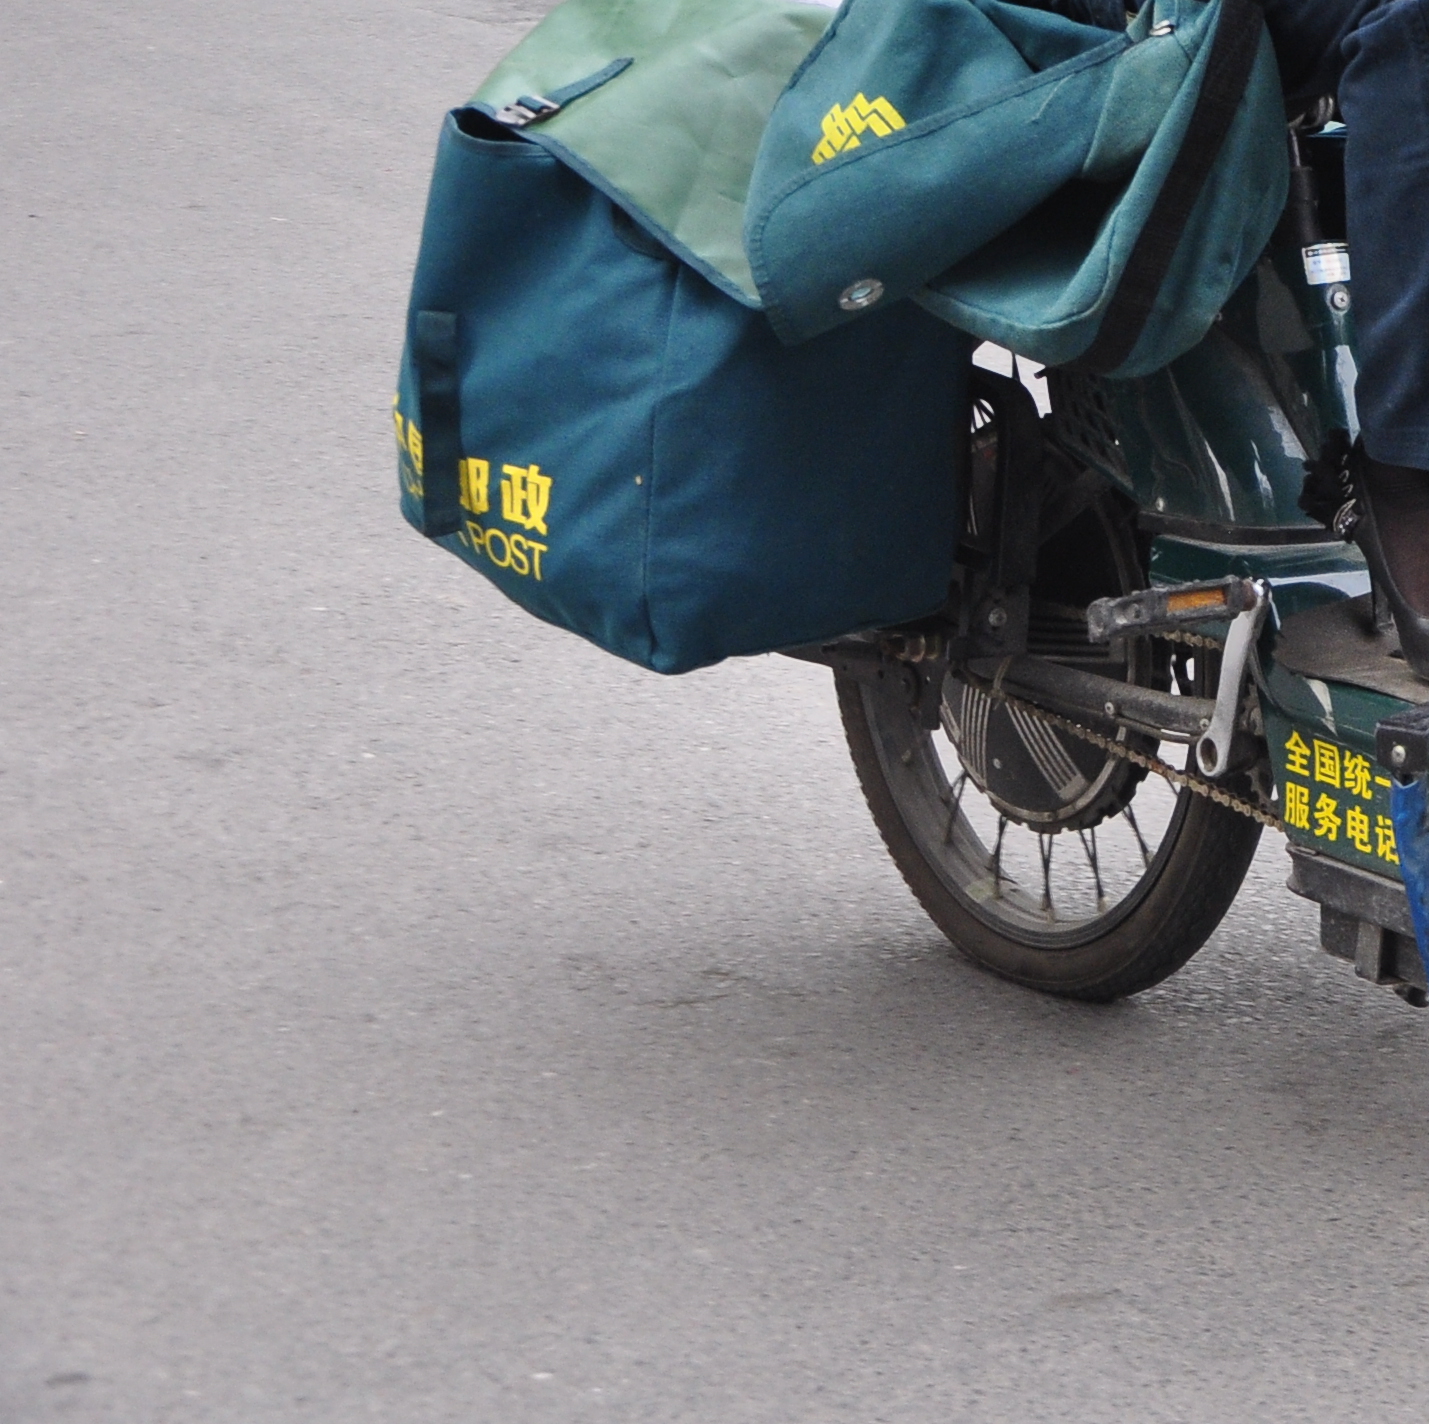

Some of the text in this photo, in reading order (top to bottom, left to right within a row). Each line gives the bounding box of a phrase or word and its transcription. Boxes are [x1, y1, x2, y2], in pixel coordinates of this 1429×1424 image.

[466, 520, 548, 582] POST
[1285, 730, 1392, 800] 全国统一
[1284, 781, 1400, 866] 服务电话
